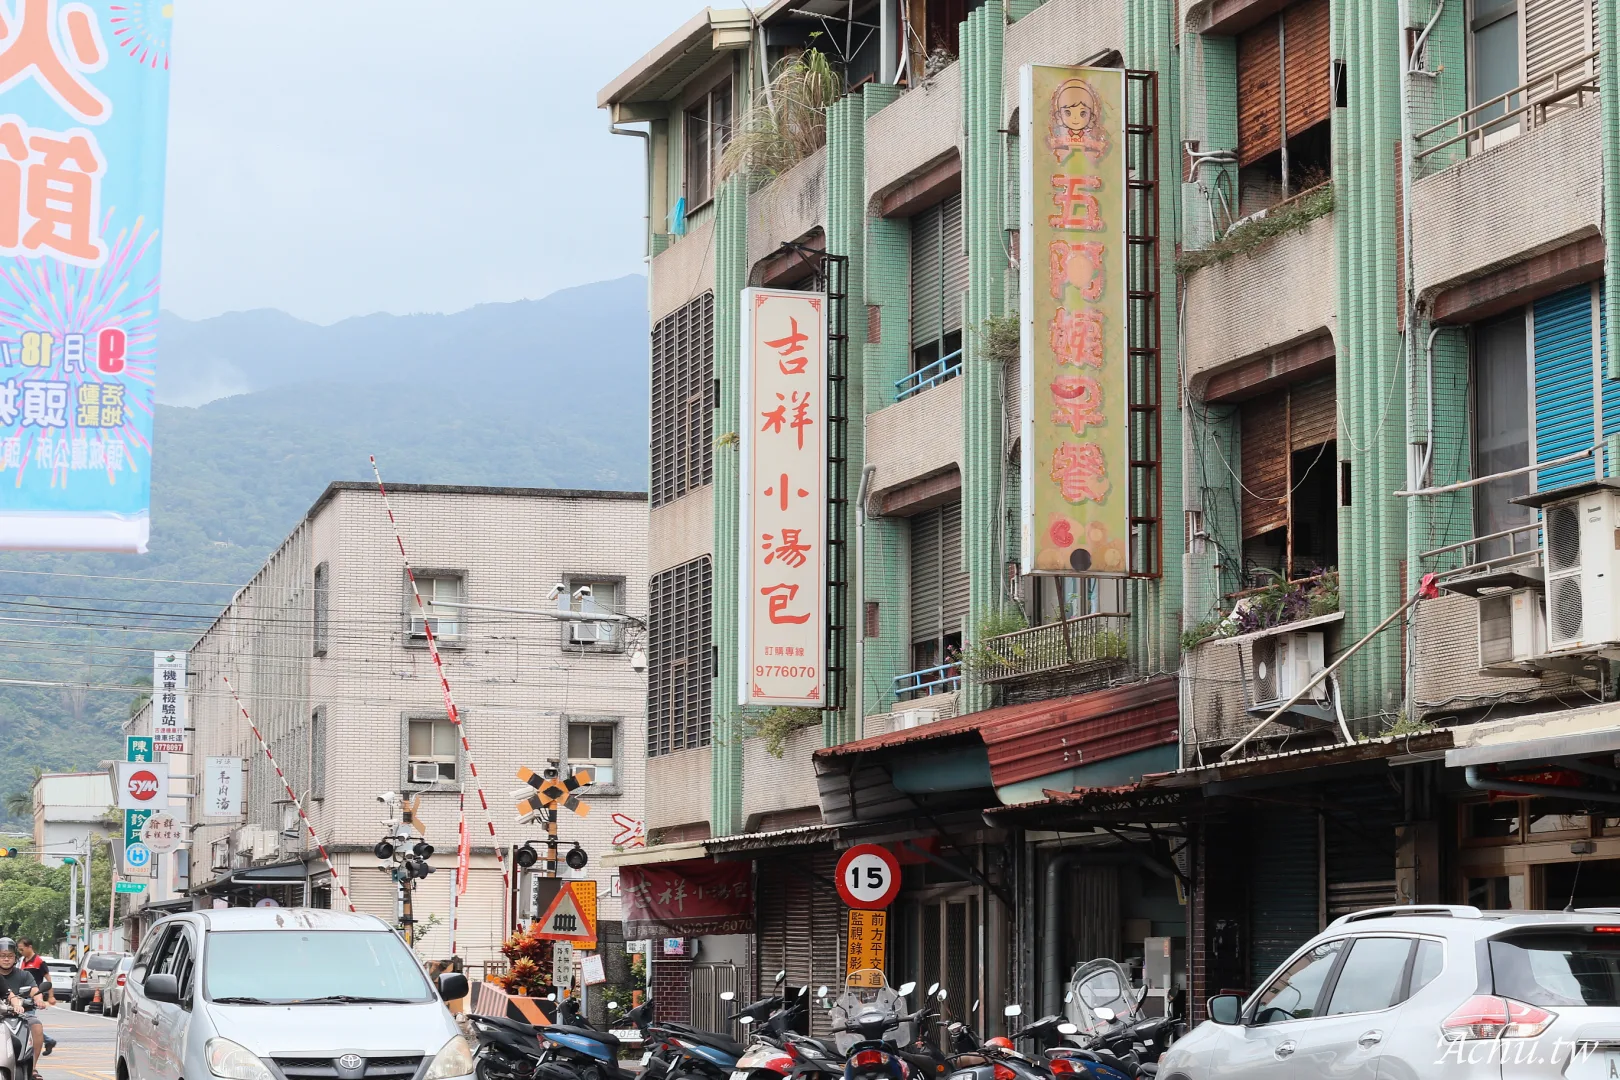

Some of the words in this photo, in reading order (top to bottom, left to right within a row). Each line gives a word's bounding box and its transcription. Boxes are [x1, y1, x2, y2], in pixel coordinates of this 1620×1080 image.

[761, 315, 814, 626] 吉祥小湯包
[765, 645, 805, 657] 訂購專線
[756, 665, 816, 678] 9776070
[162, 669, 177, 727] 機車檢驗站
[154, 743, 183, 751] 9778097
[128, 779, 158, 795] SYM
[851, 866, 883, 889] 15
[849, 913, 863, 985] 監視錄影中
[868, 913, 884, 985] 前方平交道
